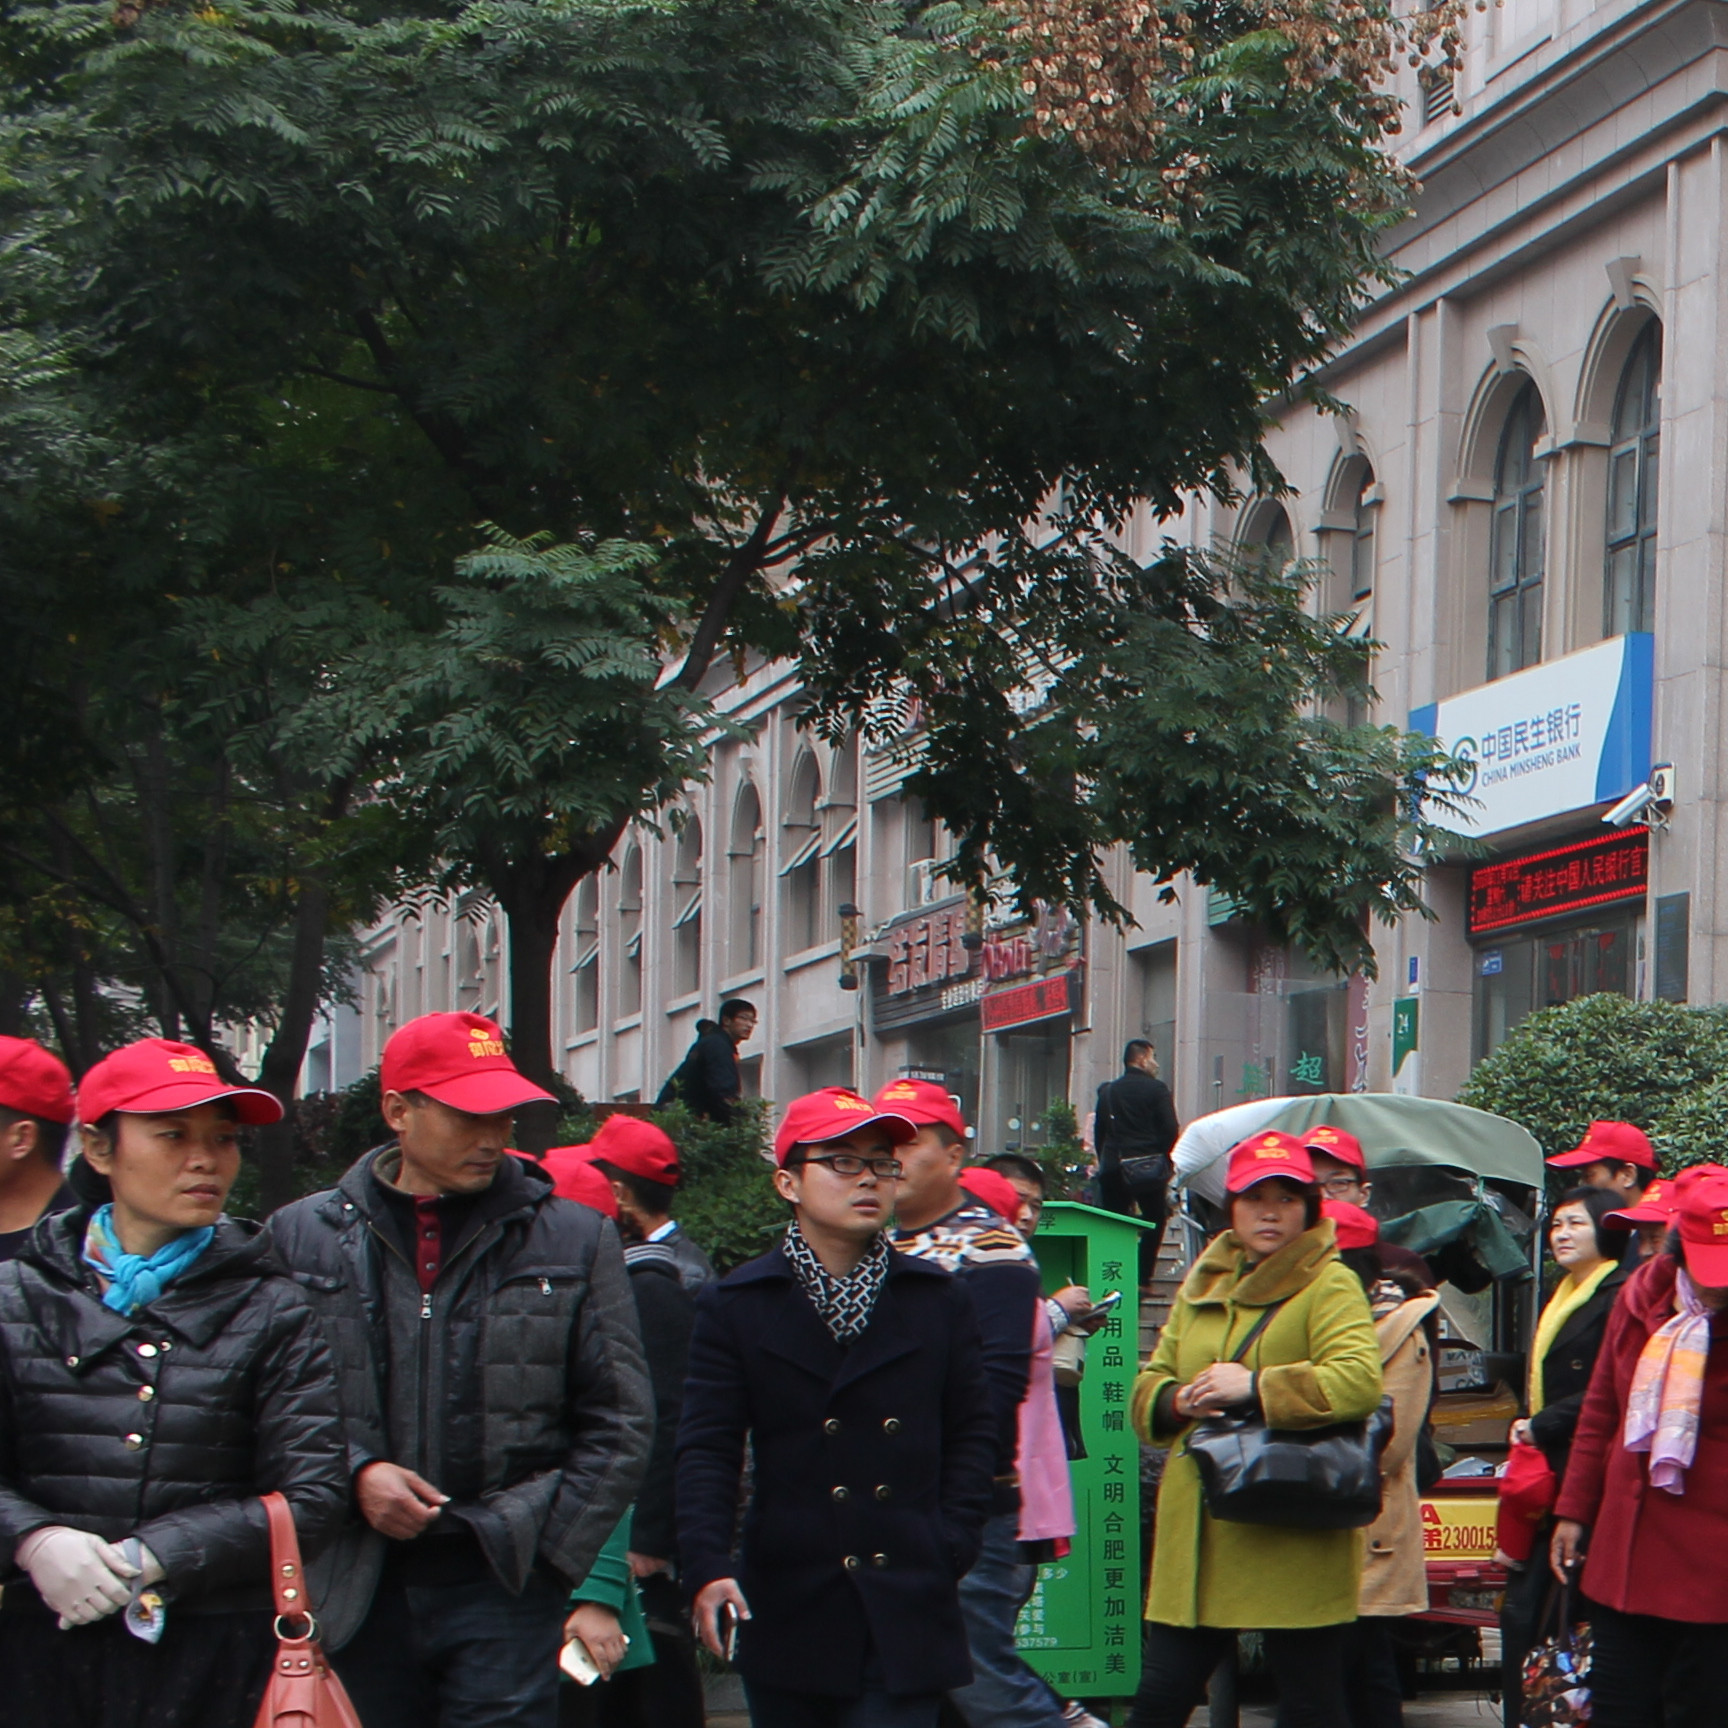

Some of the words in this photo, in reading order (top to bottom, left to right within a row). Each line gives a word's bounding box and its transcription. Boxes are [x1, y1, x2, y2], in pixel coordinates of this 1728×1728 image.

[1482, 702, 1581, 765] 中国民生银行
[1482, 766, 1508, 788] CHINA
[1509, 750, 1554, 779] MINSHENG
[1556, 742, 1581, 764] BANK
[1102, 1381, 1125, 1433] 鞋帽
